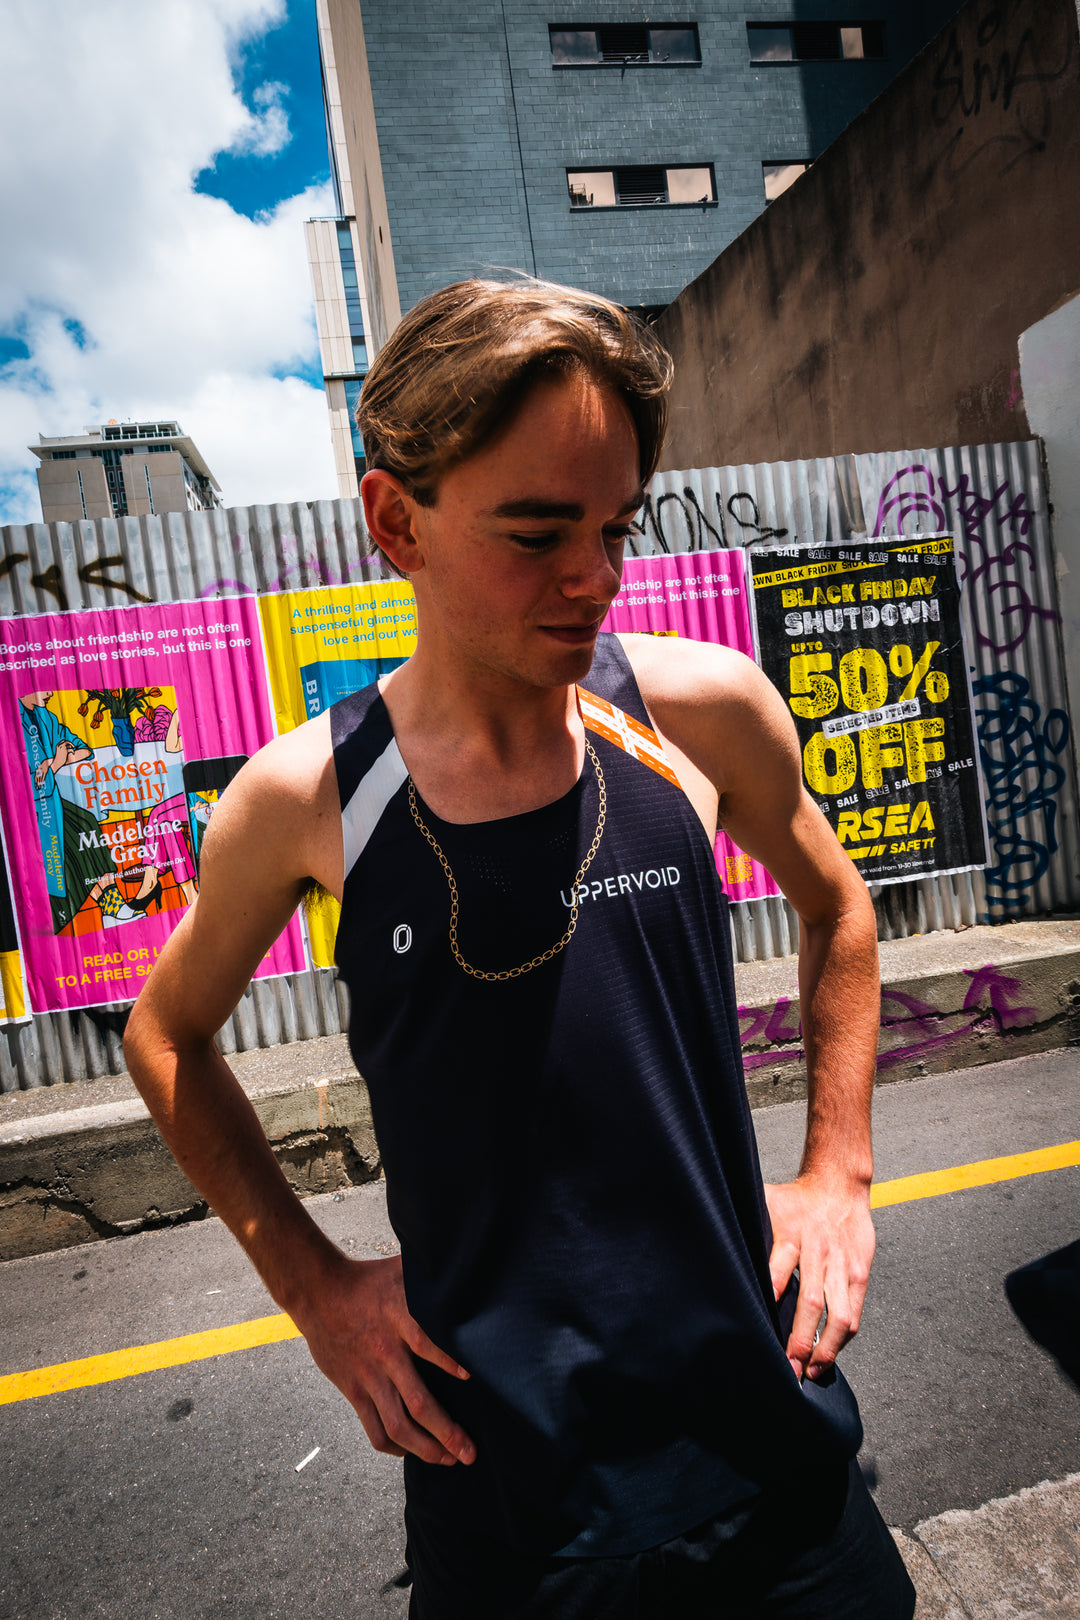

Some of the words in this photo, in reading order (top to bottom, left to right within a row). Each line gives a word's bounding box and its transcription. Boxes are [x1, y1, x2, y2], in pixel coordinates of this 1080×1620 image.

[807, 548, 831, 560] SALE
[838, 551, 861, 560] SALE
[868, 551, 889, 564] SALE
[896, 553, 919, 564] SALE
[923, 554, 947, 566] SALE
[665, 578, 682, 588] are
[685, 574, 702, 586] not
[704, 573, 729, 584] often
[775, 569, 805, 582] BLACK
[808, 563, 837, 576] FRIDAY
[627, 593, 667, 606] stories,
[669, 591, 687, 602] but
[689, 588, 708, 599] this
[709, 587, 719, 597] is
[721, 586, 741, 597] one
[781, 584, 856, 608] BLACK
[860, 576, 937, 601] FRIDAY
[293, 608, 302, 619] A
[304, 603, 351, 617] thrilling
[354, 599, 377, 612] and
[785, 599, 941, 636] SHUTDOWN
[290, 616, 364, 635] suspenseful
[367, 613, 415, 628] glimpse
[323, 636, 349, 646] love
[352, 631, 375, 643] and
[378, 630, 399, 640] our
[0, 642, 42, 655] Books
[46, 636, 85, 650] about
[87, 630, 154, 646] friendship
[157, 628, 179, 640] are
[182, 624, 205, 637] not
[207, 622, 240, 634] often
[790, 642, 806, 653] UP
[806, 641, 823, 651] TO
[0, 655, 57, 672] escribed
[60, 655, 77, 665] as
[79, 651, 108, 663] love
[111, 646, 160, 660] stories,
[162, 642, 186, 654] but
[187, 640, 212, 652] this
[215, 638, 227, 649] is
[229, 638, 252, 648] one
[789, 640, 950, 719] 50%
[827, 713, 883, 734] SELECTED
[885, 702, 918, 720] ITEMS
[803, 717, 946, 794] OFF
[75, 758, 169, 786] Chosen
[837, 794, 859, 808] SALE
[865, 784, 890, 799] SALE
[895, 778, 916, 790] SAL
[948, 758, 974, 772] SALE
[36, 780, 52, 829] Family
[83, 778, 167, 810] Family
[78, 818, 183, 852] Madeleine
[836, 801, 936, 844] RSEA
[110, 839, 160, 864] Gray
[889, 837, 937, 854] SAFETY
[45, 849, 55, 876] Gray
[49, 834, 64, 892] Madeleine
[124, 865, 147, 877] author
[156, 859, 175, 869] Green
[175, 856, 186, 865] Dot
[560, 866, 681, 908] UPPERVOID
[83, 952, 124, 968] READ
[127, 948, 150, 962] OR
[56, 975, 77, 988] TO
[81, 973, 92, 986] A
[95, 967, 132, 983] FREE
